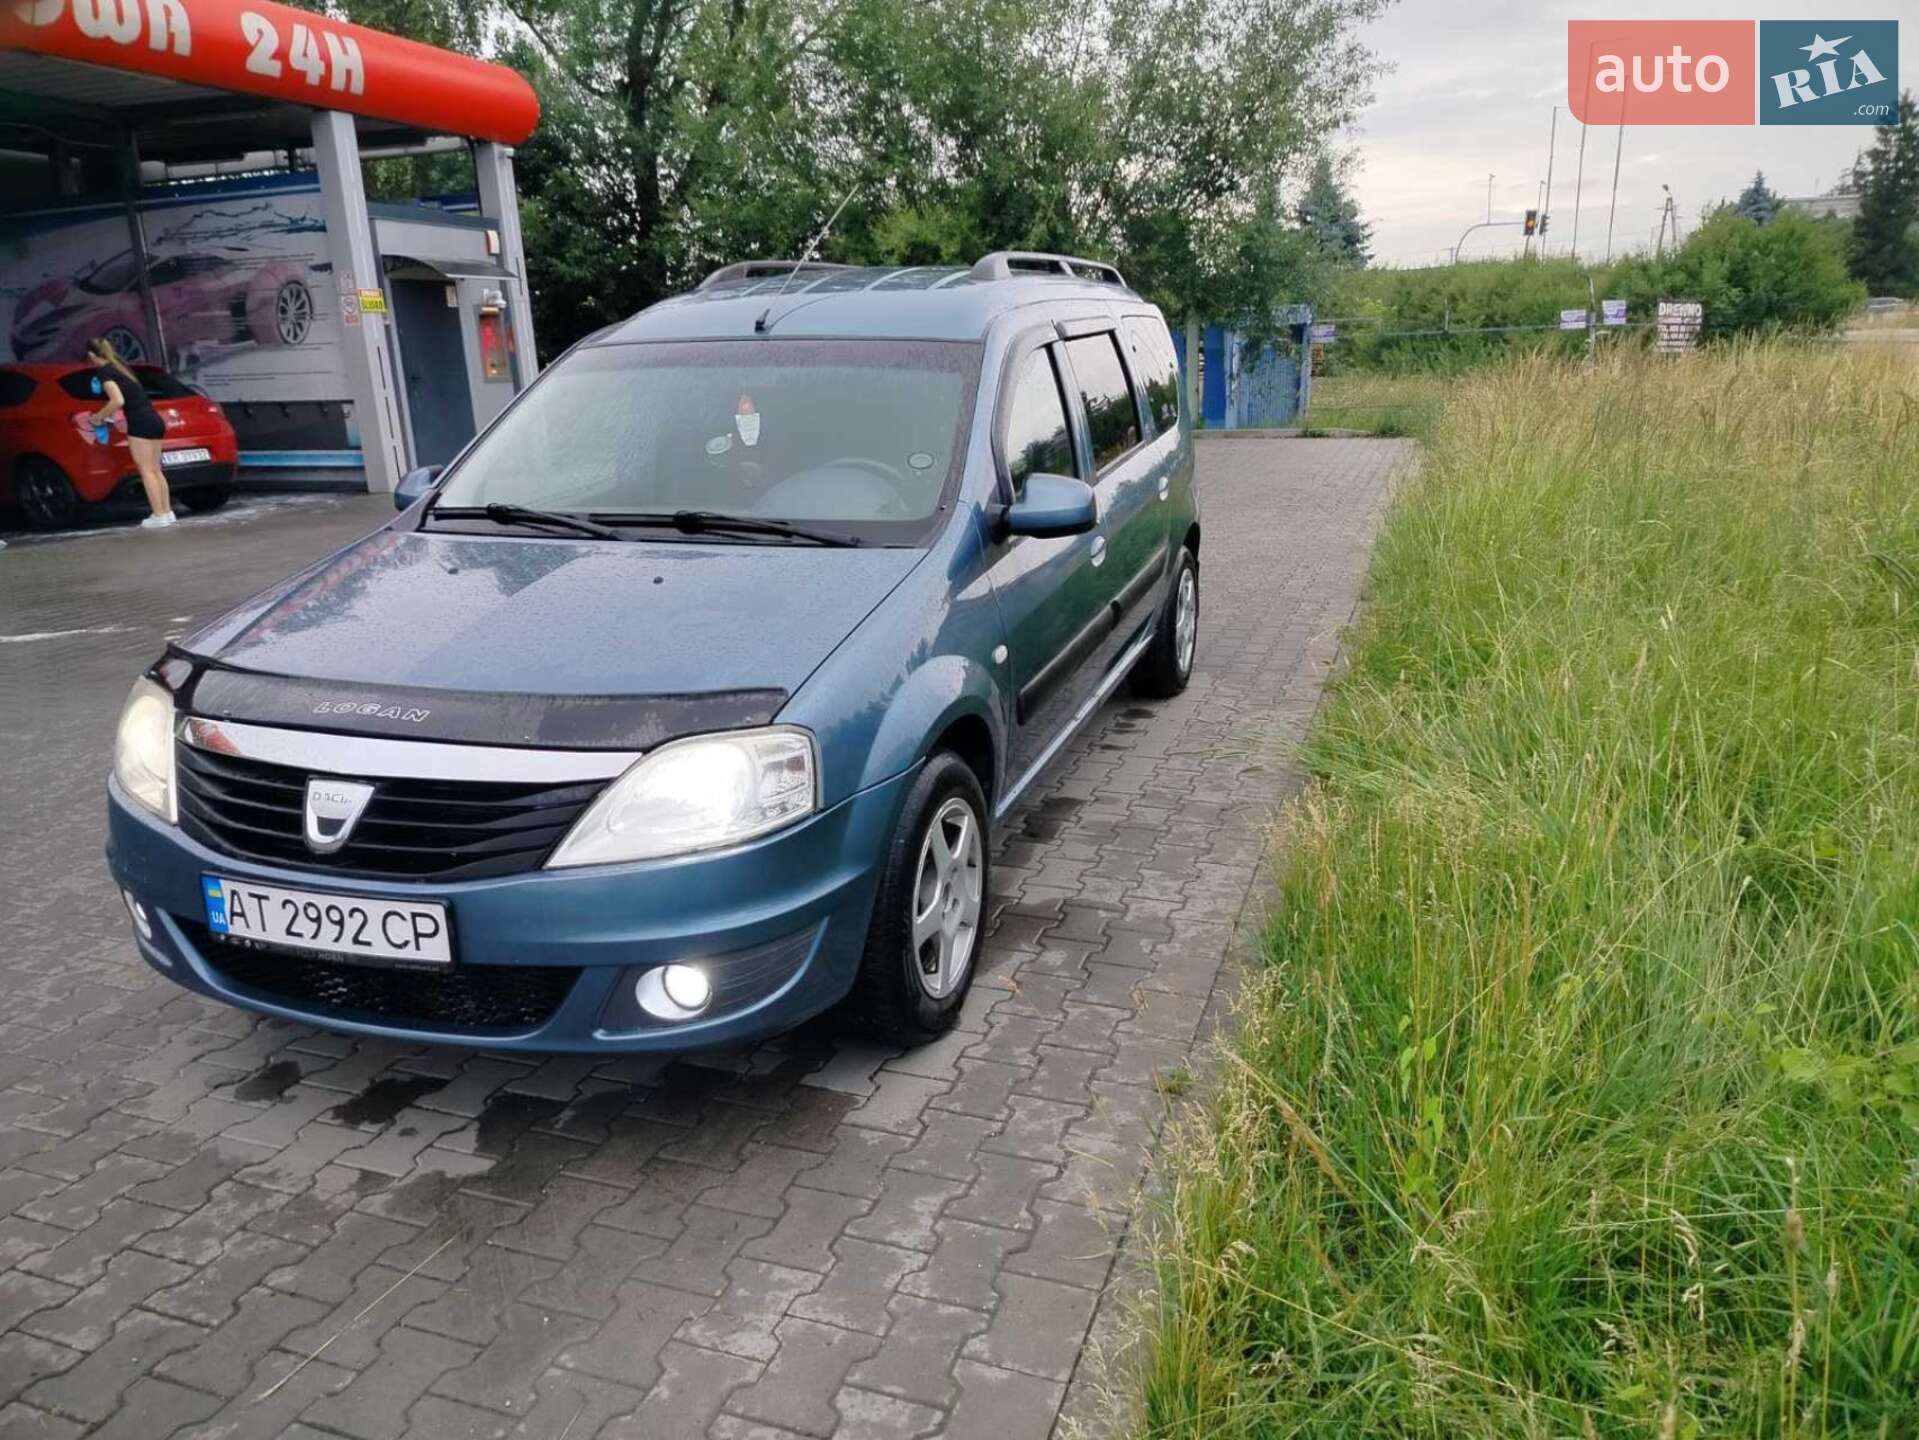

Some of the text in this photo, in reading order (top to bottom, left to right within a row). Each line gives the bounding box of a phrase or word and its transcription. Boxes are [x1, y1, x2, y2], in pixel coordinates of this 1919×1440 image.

[240, 10, 365, 96] 24H
[312, 701, 430, 721] LOGAN
[211, 911, 226, 925] UA
[230, 889, 440, 952] AT 2992 CP
